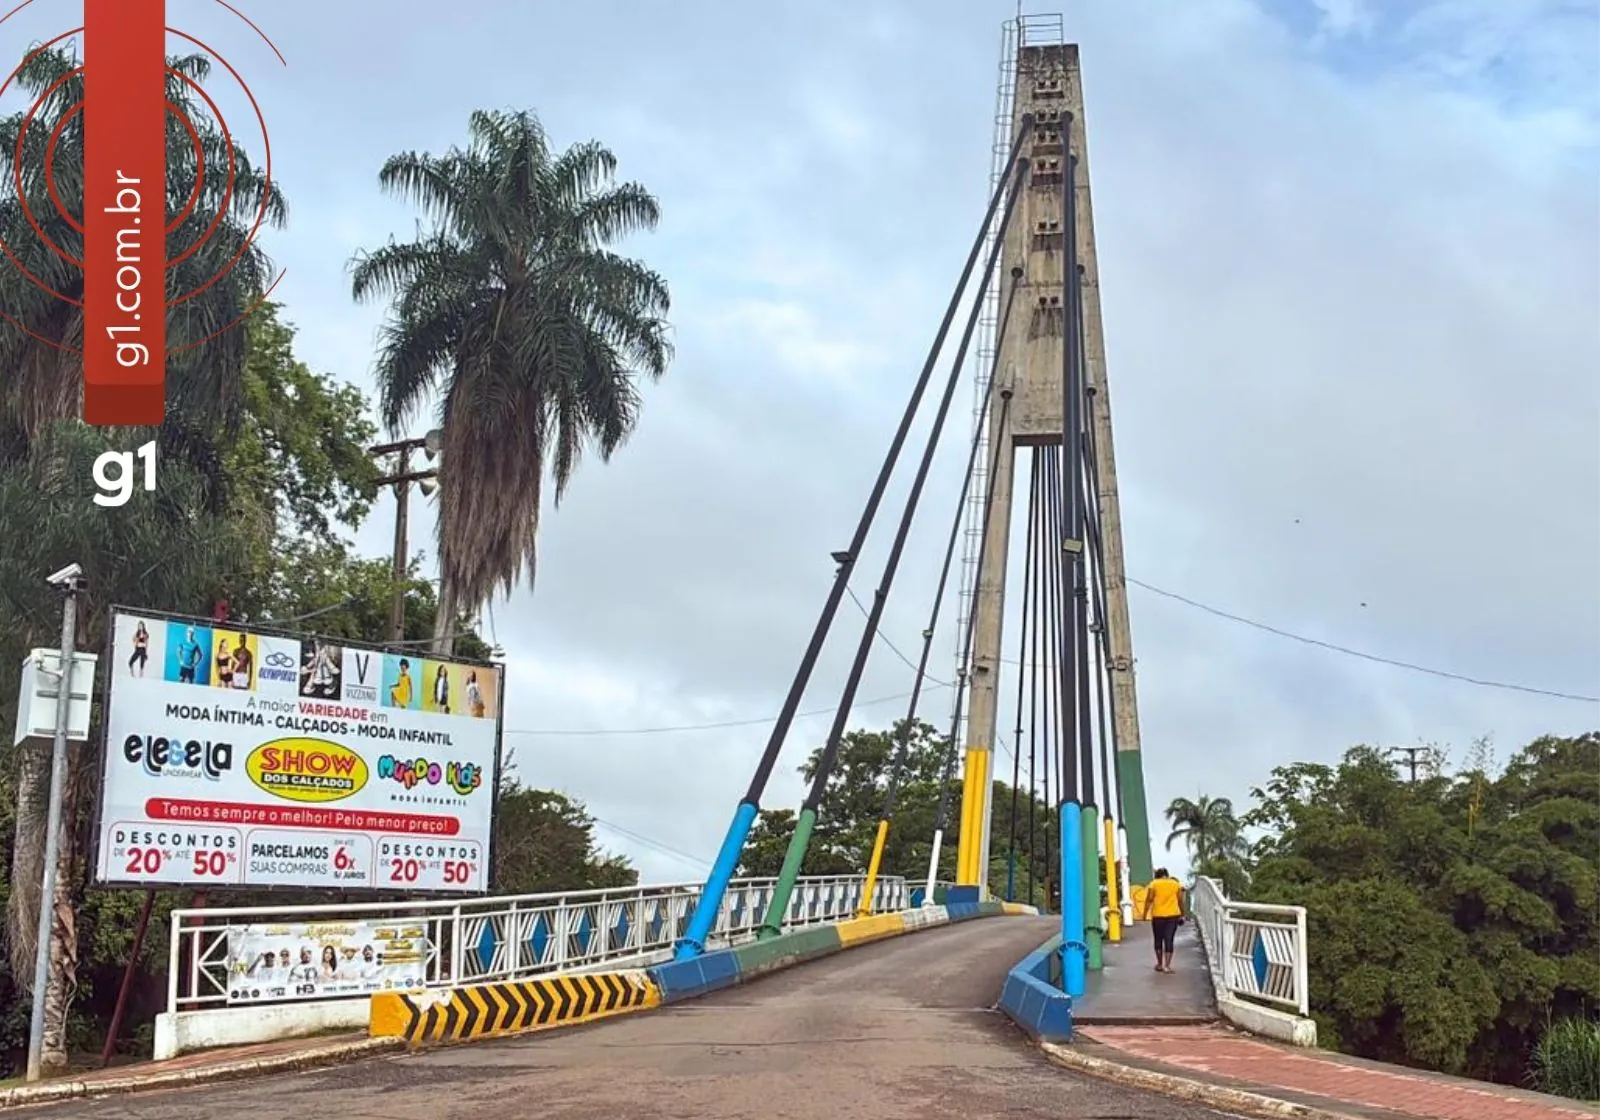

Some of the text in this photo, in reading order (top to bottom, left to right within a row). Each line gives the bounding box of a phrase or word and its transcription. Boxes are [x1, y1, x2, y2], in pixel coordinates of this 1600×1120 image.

[246, 696, 388, 723] A maior VARIEDADE em
[166, 703, 211, 721] MODA
[214, 704, 265, 727] ÍNTIMA
[275, 716, 348, 734] CALÇADOS
[357, 725, 396, 740] MODA
[399, 728, 453, 746] INFANTIL
[260, 747, 356, 776] SHOW
[264, 773, 352, 788] DOS CALÇADOS
[391, 794, 418, 802] MODA
[162, 802, 448, 833] Temos sempre o melhor! Pelo menor preço!
[116, 831, 236, 848] DESCONTOS
[126, 847, 172, 874] 20%
[193, 850, 236, 875] 50%
[252, 844, 329, 859] PARCELAMOS
[382, 844, 477, 859] DESCONTOS
[251, 861, 328, 875] SUAS COMPRAS
[390, 859, 427, 882] 20%
[443, 861, 477, 884] 50%
